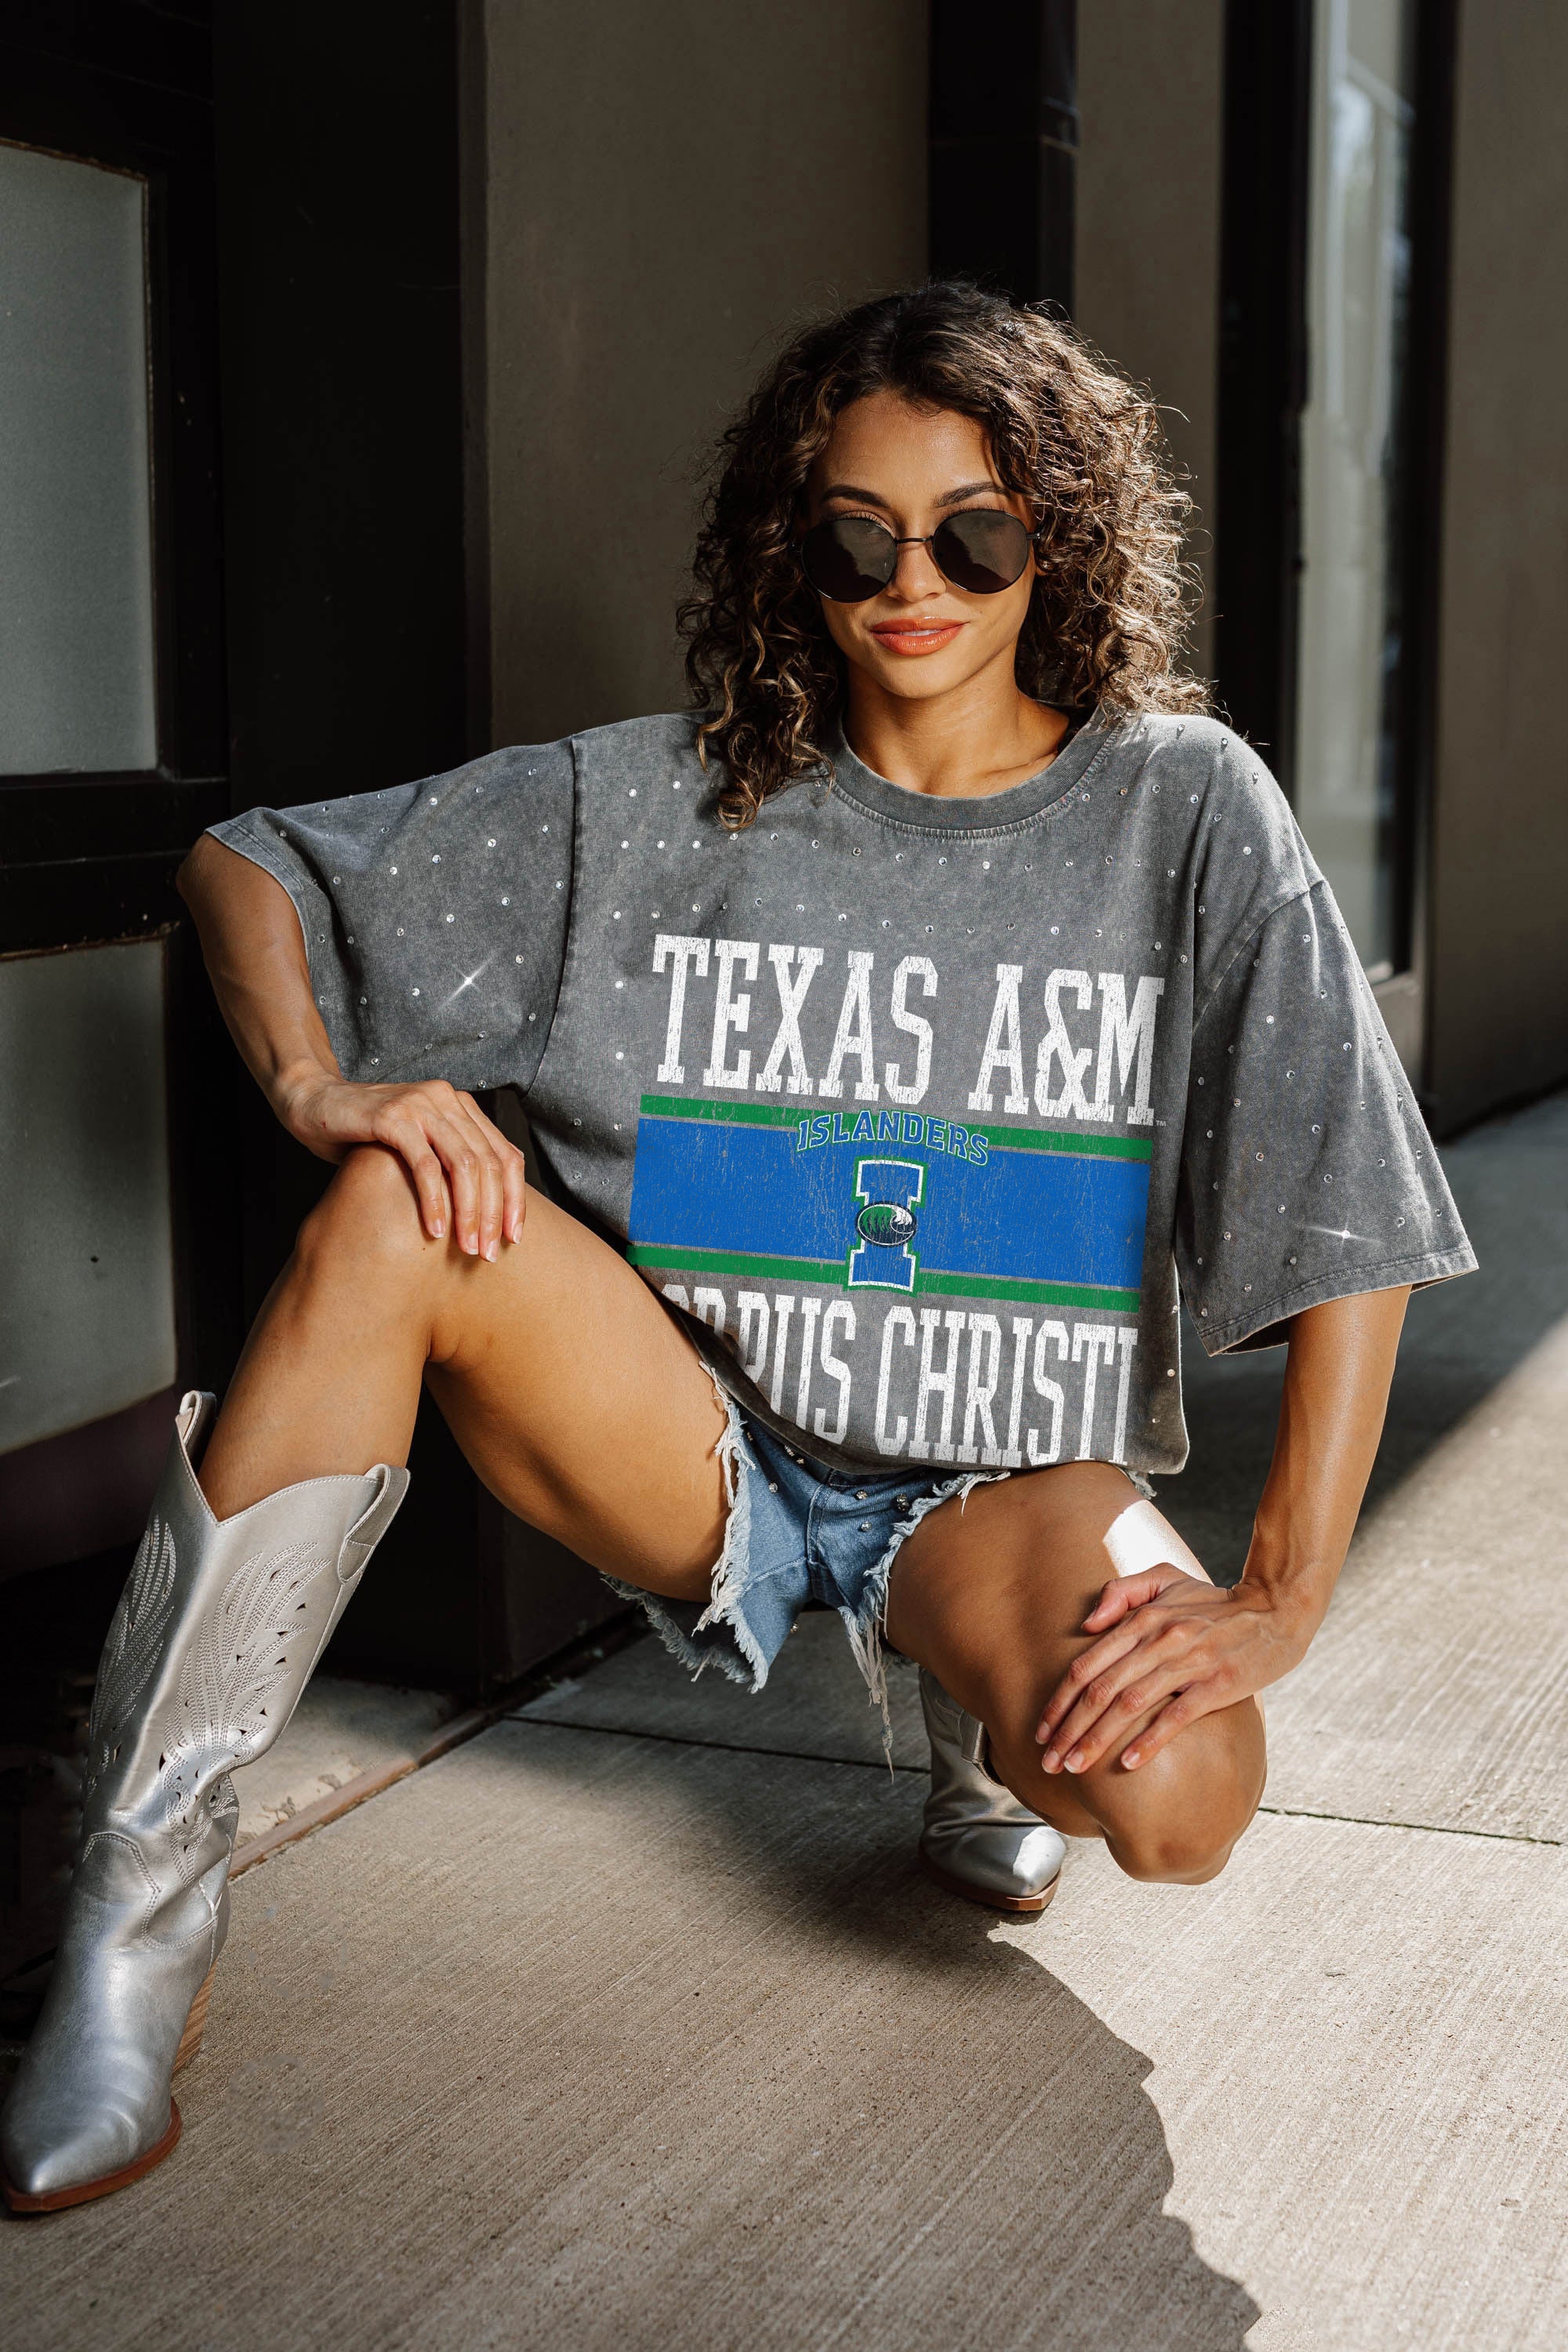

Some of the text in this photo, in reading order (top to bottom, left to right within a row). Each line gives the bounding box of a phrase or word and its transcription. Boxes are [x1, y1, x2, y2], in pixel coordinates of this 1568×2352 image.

[652, 934, 1165, 1126] TEXAS A&M
[797, 1109, 989, 1166] ISLANDERS
[661, 1283, 1138, 1468] PUS CHRISTI
